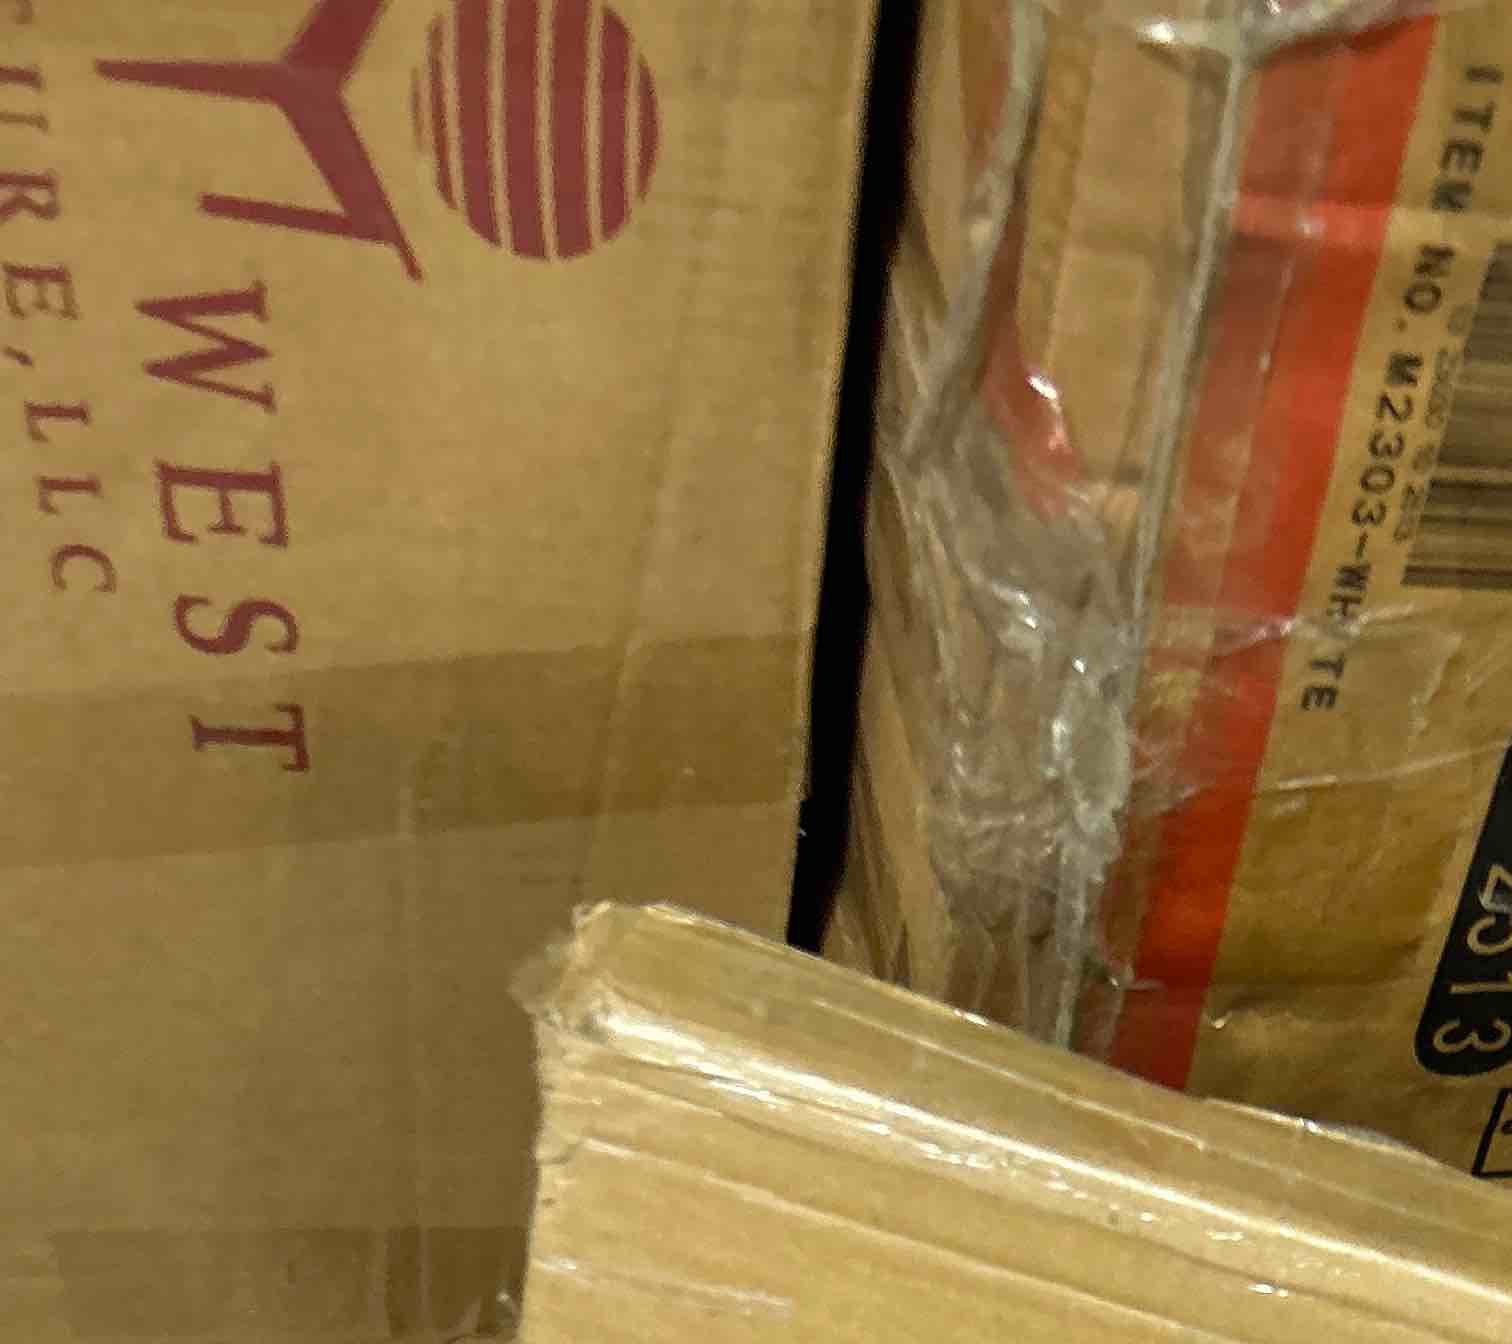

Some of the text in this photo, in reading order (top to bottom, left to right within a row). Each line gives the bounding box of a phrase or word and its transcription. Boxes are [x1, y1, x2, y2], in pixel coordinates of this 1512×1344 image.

[1429, 64, 1504, 213] ITEM
[1396, 244, 1455, 332] NO.
[25, 400, 117, 594] LLC
[135, 279, 310, 773] WEST
[1301, 351, 1425, 712] M2303-WHTE
